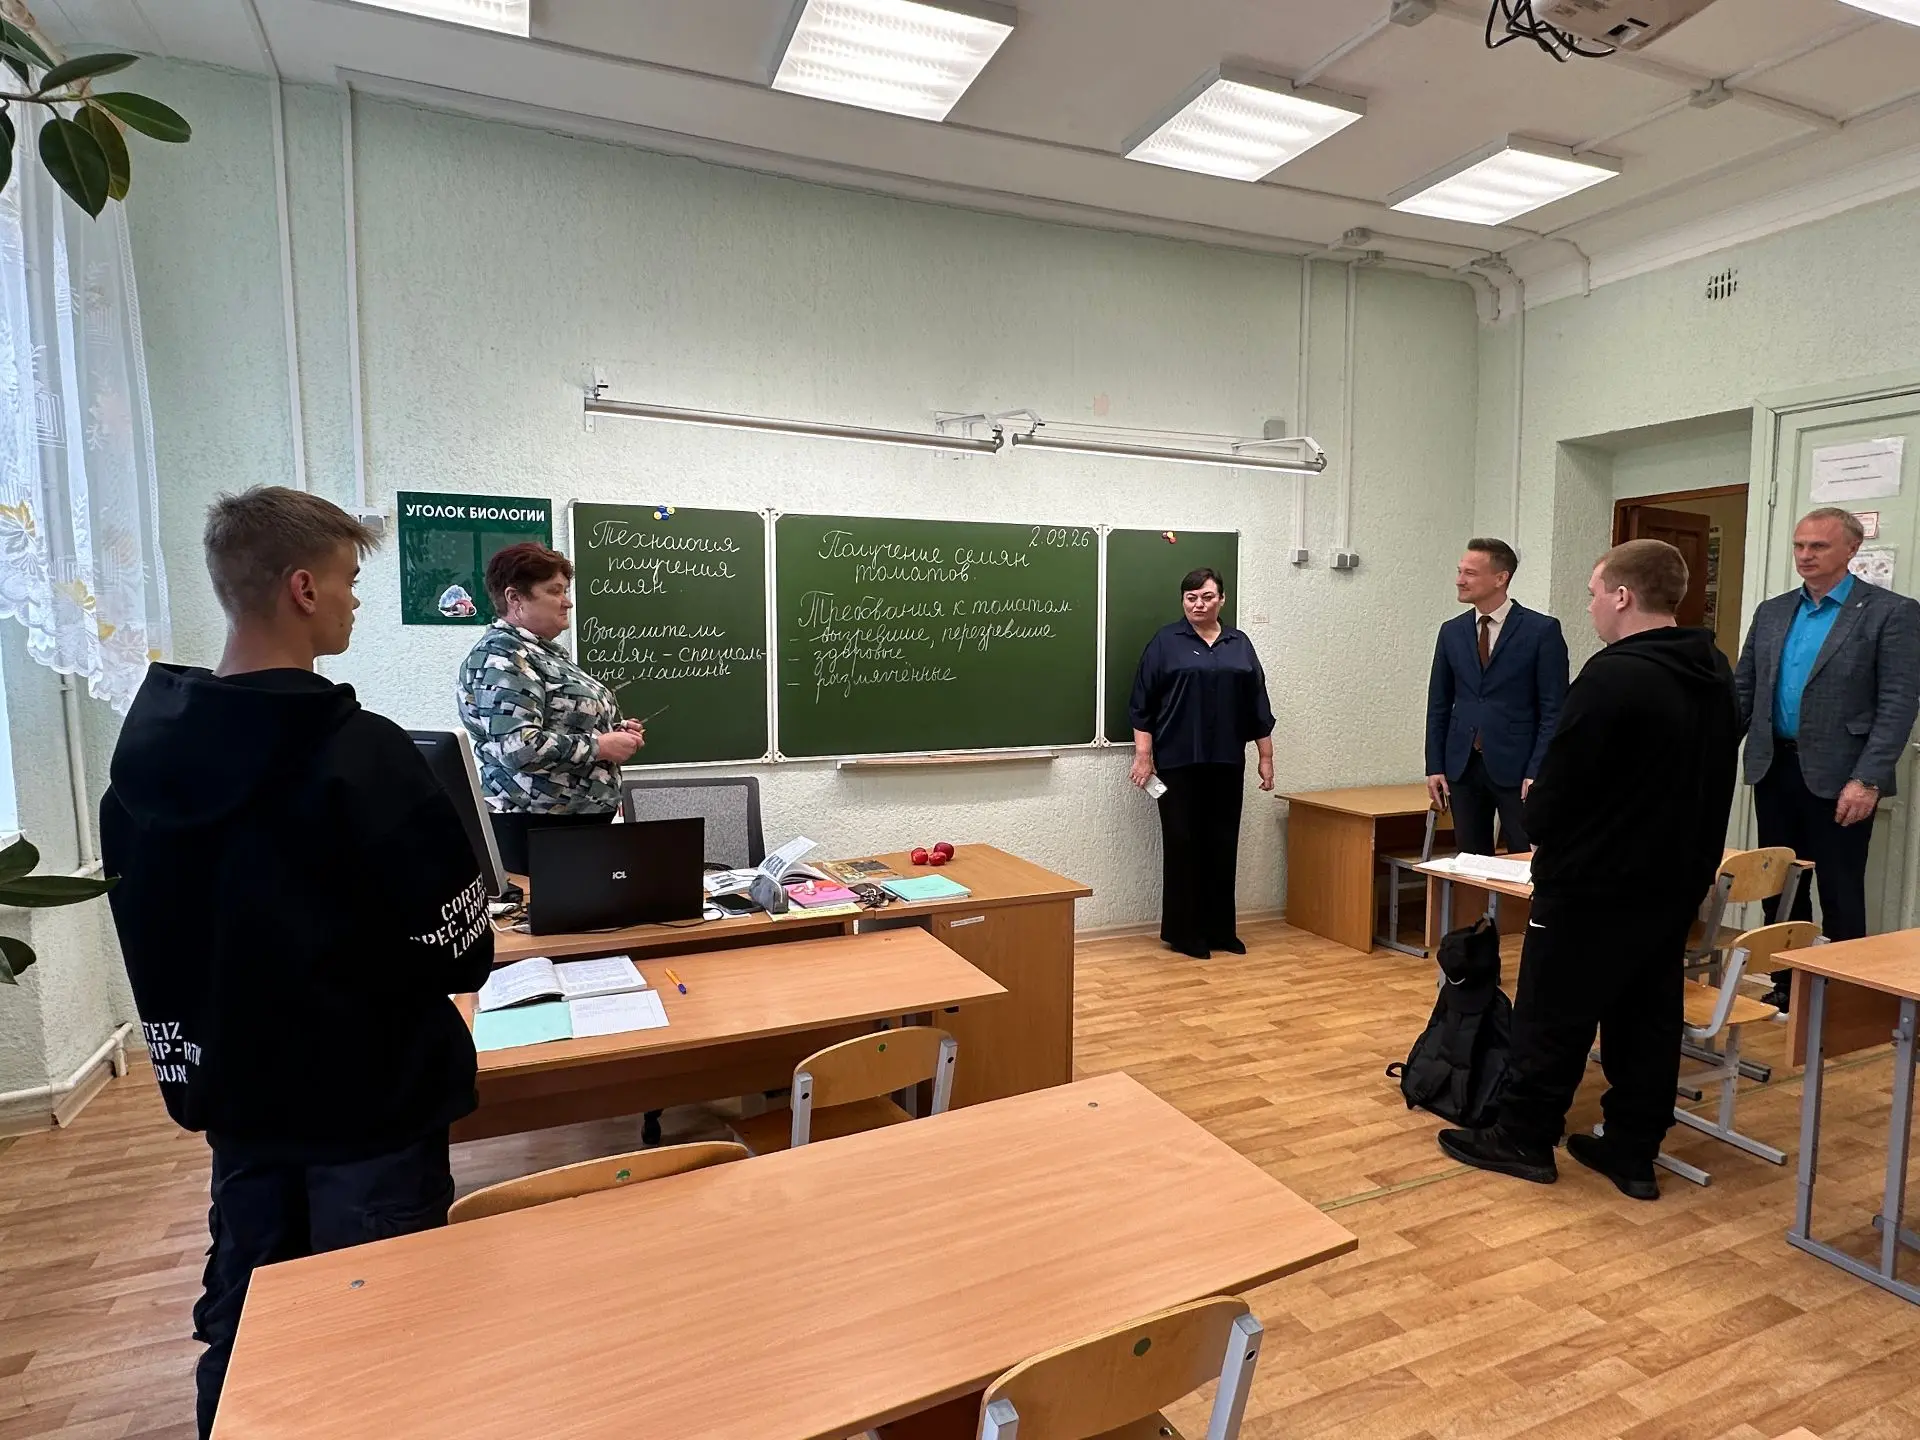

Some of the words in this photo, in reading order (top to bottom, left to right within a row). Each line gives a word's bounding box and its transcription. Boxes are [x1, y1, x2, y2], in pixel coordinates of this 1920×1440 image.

[405, 504, 466, 519] УГОЛОК
[469, 506, 545, 522] БИОЛОГИИ
[588, 520, 740, 553] Технология
[818, 530, 944, 569] Получение
[954, 548, 1030, 568] семян
[1029, 525, 1090, 548] 2.09.26
[608, 556, 736, 582] получения
[798, 590, 945, 628] Требования
[953, 600, 966, 616] к
[581, 616, 726, 648] Выделители
[942, 618, 1056, 652] перезревшие
[587, 648, 657, 664] семян
[814, 646, 905, 676] здоровые
[589, 665, 627, 682] ные
[632, 664, 731, 681] машины
